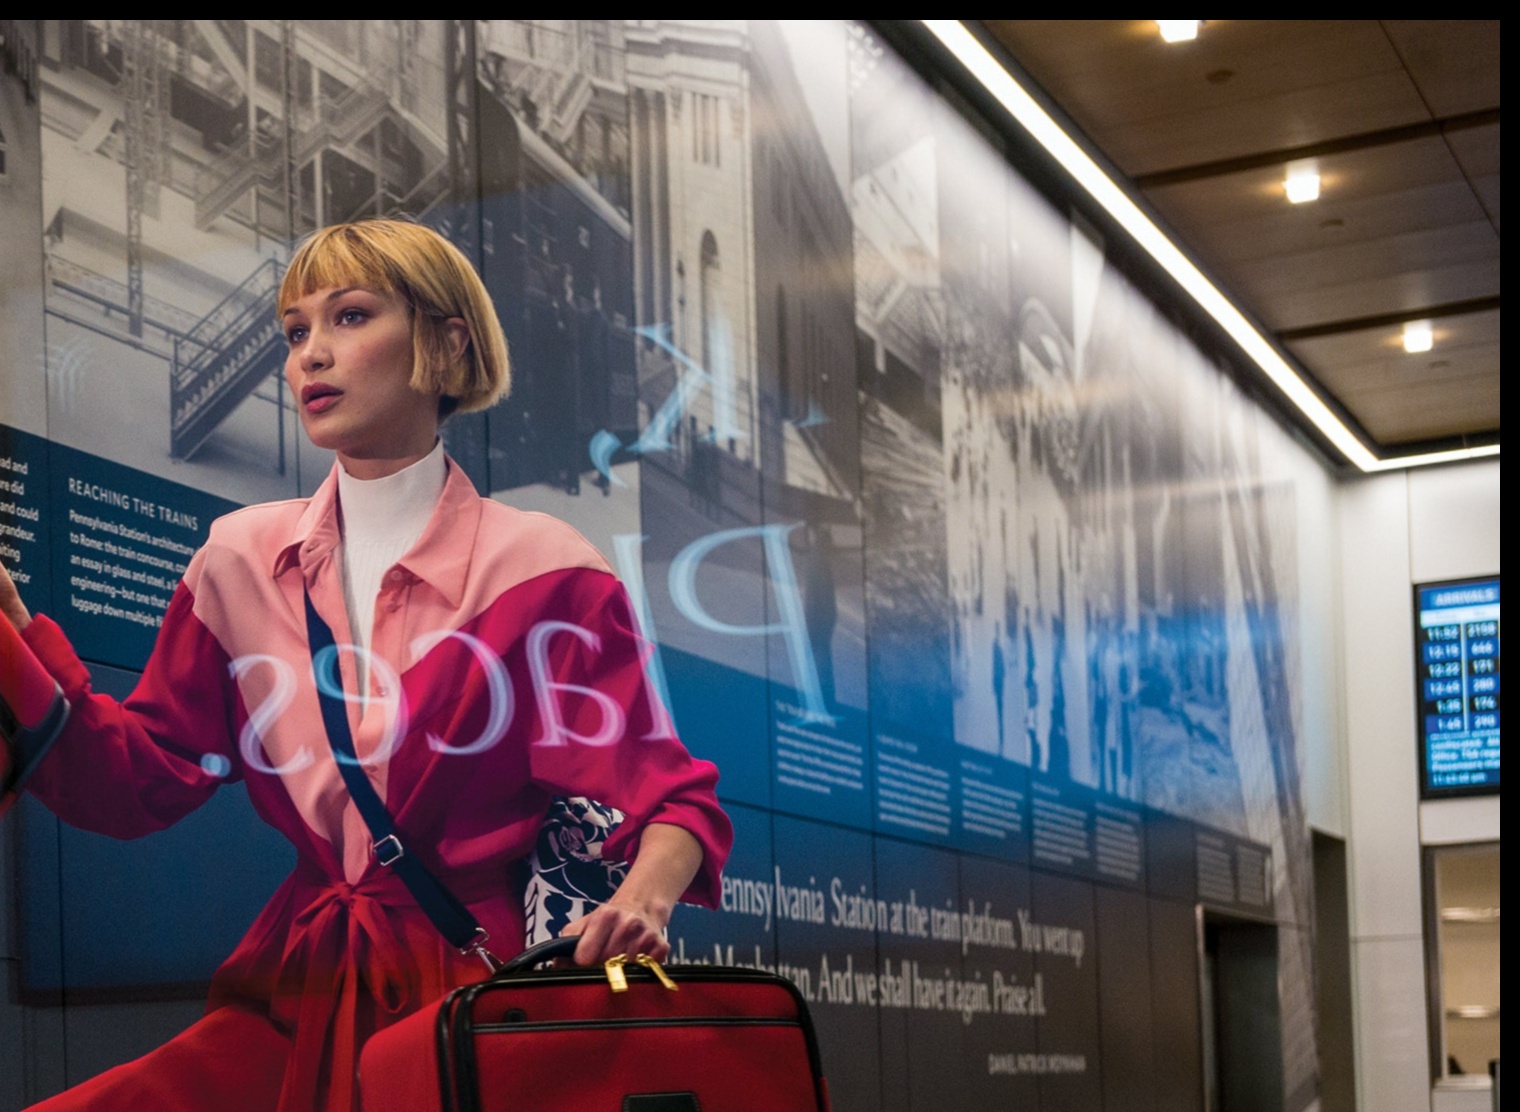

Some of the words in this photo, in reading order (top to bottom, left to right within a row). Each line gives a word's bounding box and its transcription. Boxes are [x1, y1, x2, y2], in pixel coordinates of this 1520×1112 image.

[12, 461, 28, 475] and
[0, 501, 16, 515] and
[15, 506, 39, 522] could
[68, 477, 130, 510] REACHING
[132, 497, 155, 518] THE
[157, 505, 199, 532] TRAINS
[1434, 587, 1495, 607] ARRIVALS
[721, 865, 826, 932] ennsylvania
[830, 877, 889, 933] Station
[905, 888, 930, 939] the
[817, 953, 853, 1006] And
[854, 973, 878, 1008] we
[879, 957, 912, 1008] shall
[993, 970, 1028, 1016] Praise
